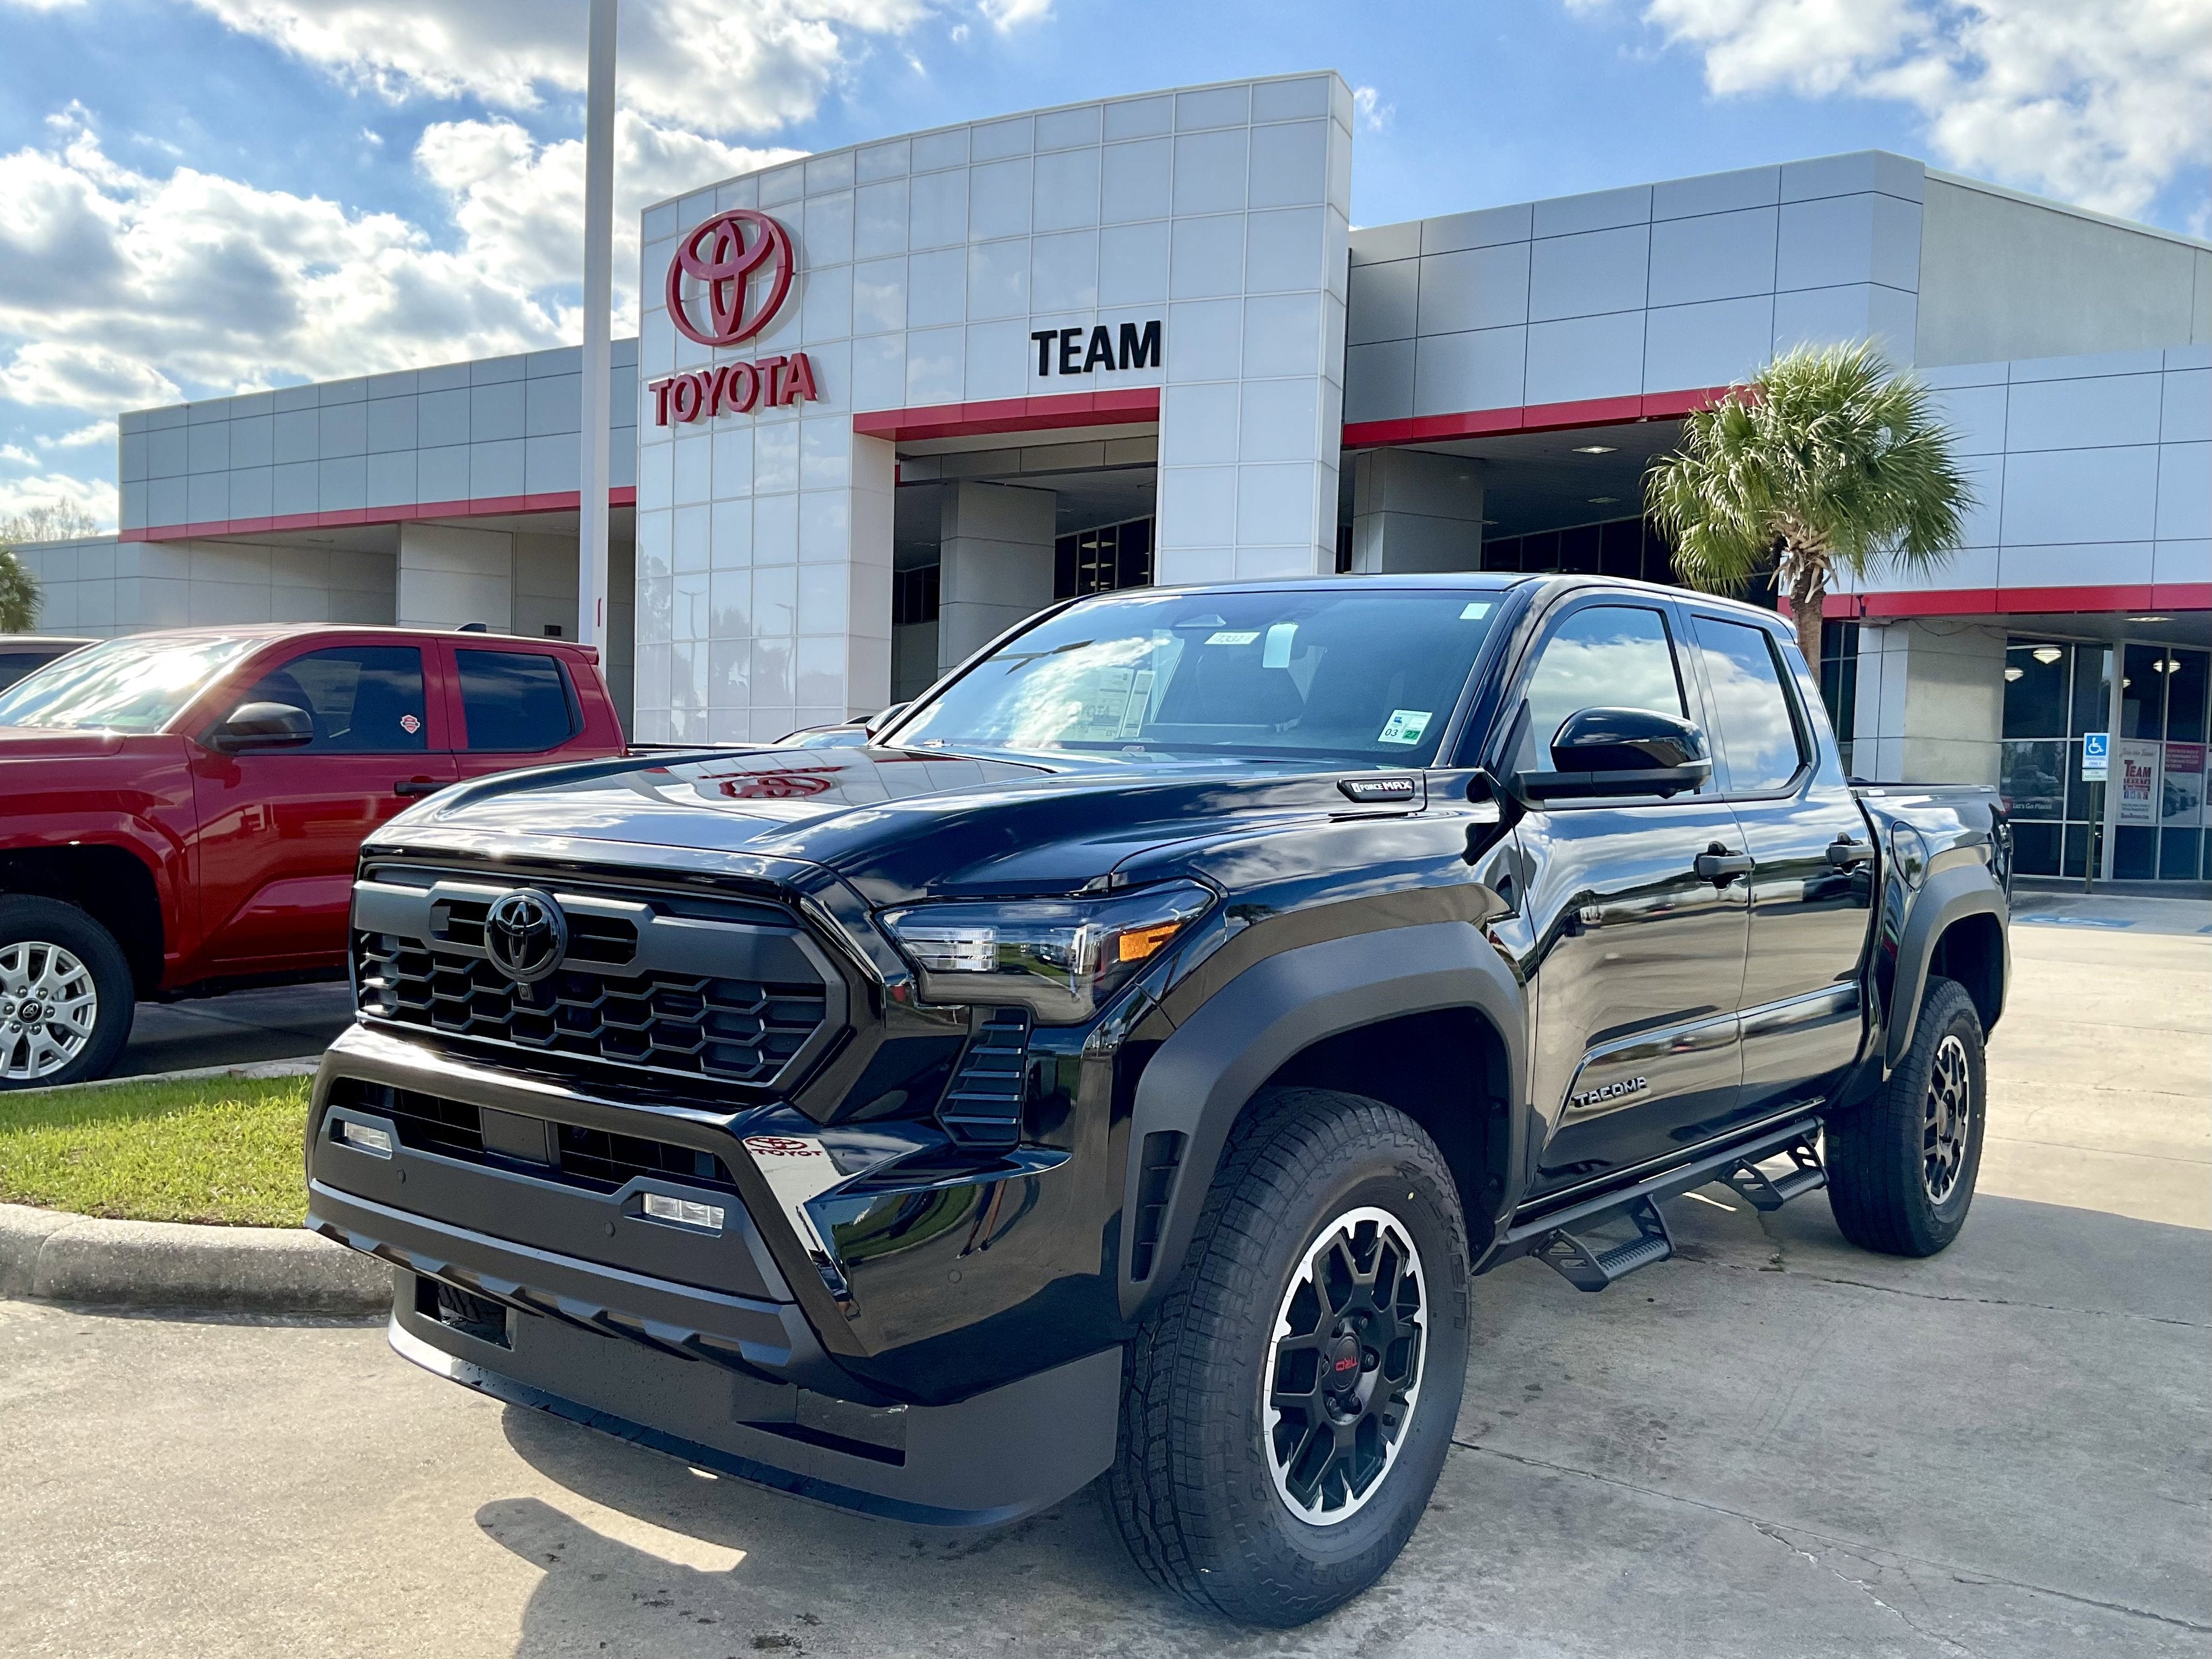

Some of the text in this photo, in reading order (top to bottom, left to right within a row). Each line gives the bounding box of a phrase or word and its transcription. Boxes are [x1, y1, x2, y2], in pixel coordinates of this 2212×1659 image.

[1031, 320, 1161, 376] TEAM
[648, 352, 818, 427] TOYOTA
[1384, 728, 1398, 737] 03
[1404, 730, 1421, 740] 27
[2124, 759, 2152, 778] TEAM
[1382, 781, 1413, 791] MAX
[1572, 1076, 1647, 1107] TACOMA
[1335, 1356, 1358, 1372] TRD
